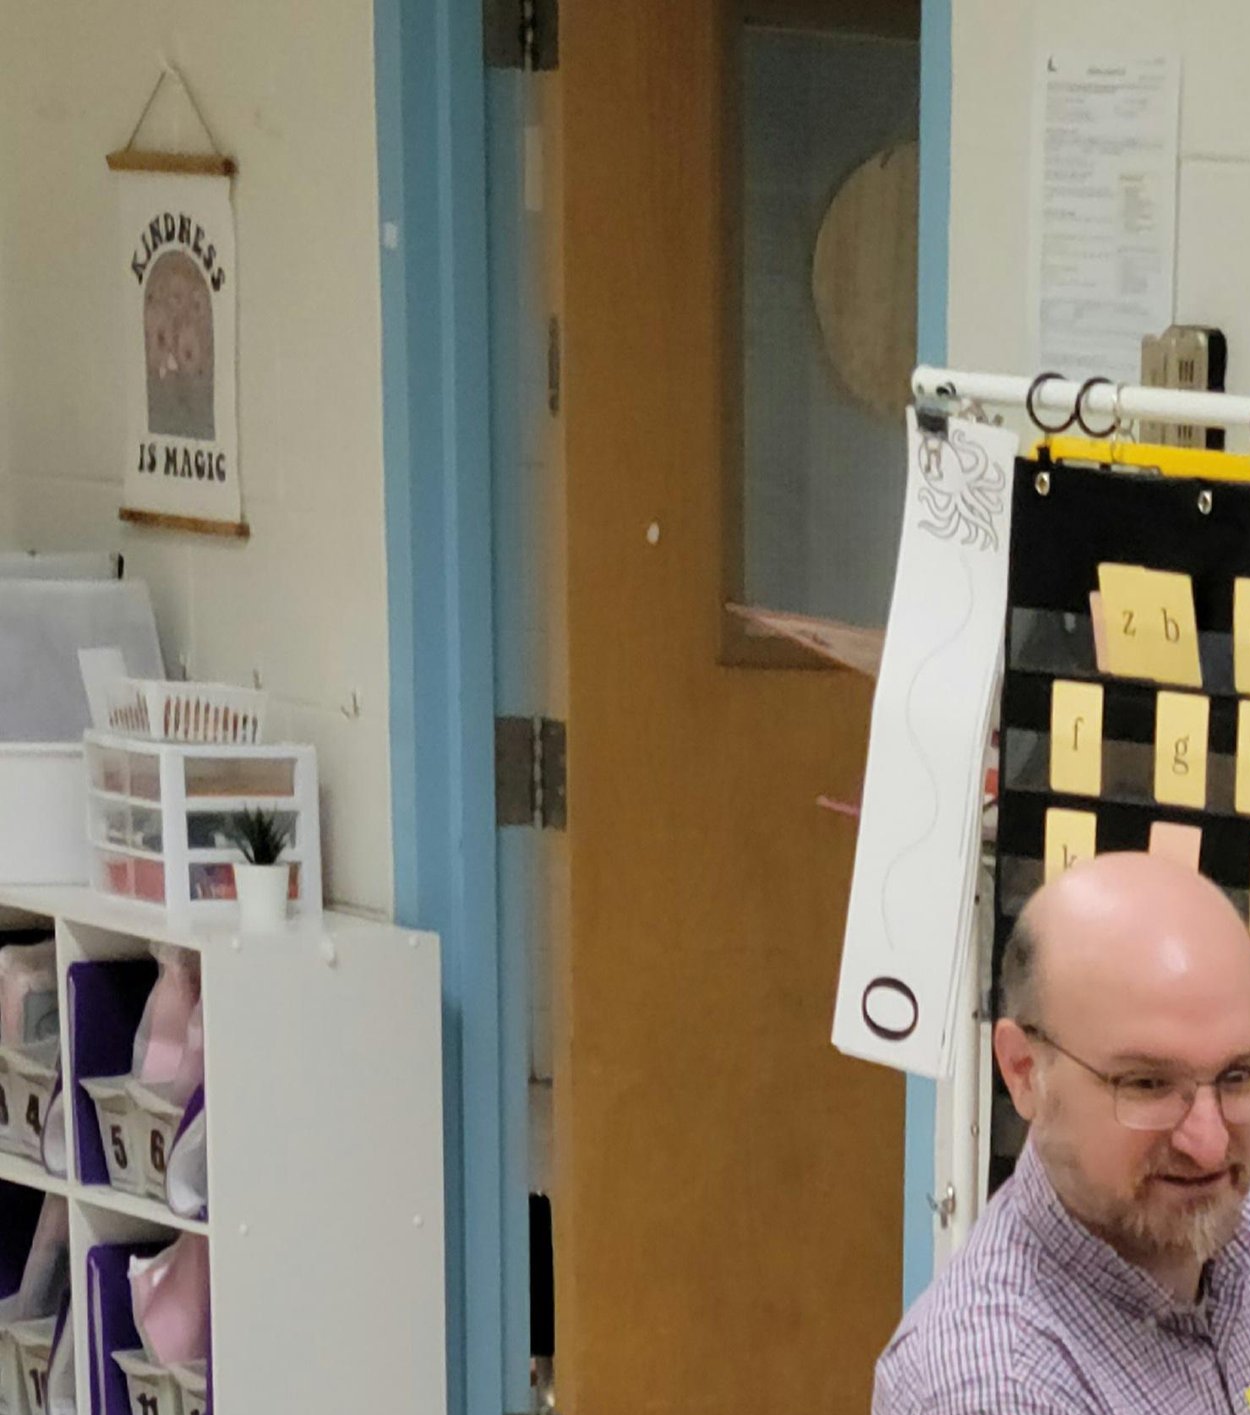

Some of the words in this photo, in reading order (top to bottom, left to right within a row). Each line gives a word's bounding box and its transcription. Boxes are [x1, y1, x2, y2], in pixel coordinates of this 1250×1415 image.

[130, 211, 226, 292] KINDNESS
[138, 443, 157, 474] IS
[164, 446, 227, 483] MAGIC
[1121, 607, 1137, 638] z
[1159, 608, 1181, 643] b
[1070, 716, 1086, 752] f
[1171, 735, 1191, 773] g
[109, 1124, 129, 1170] 5
[150, 1128, 167, 1174] 6
